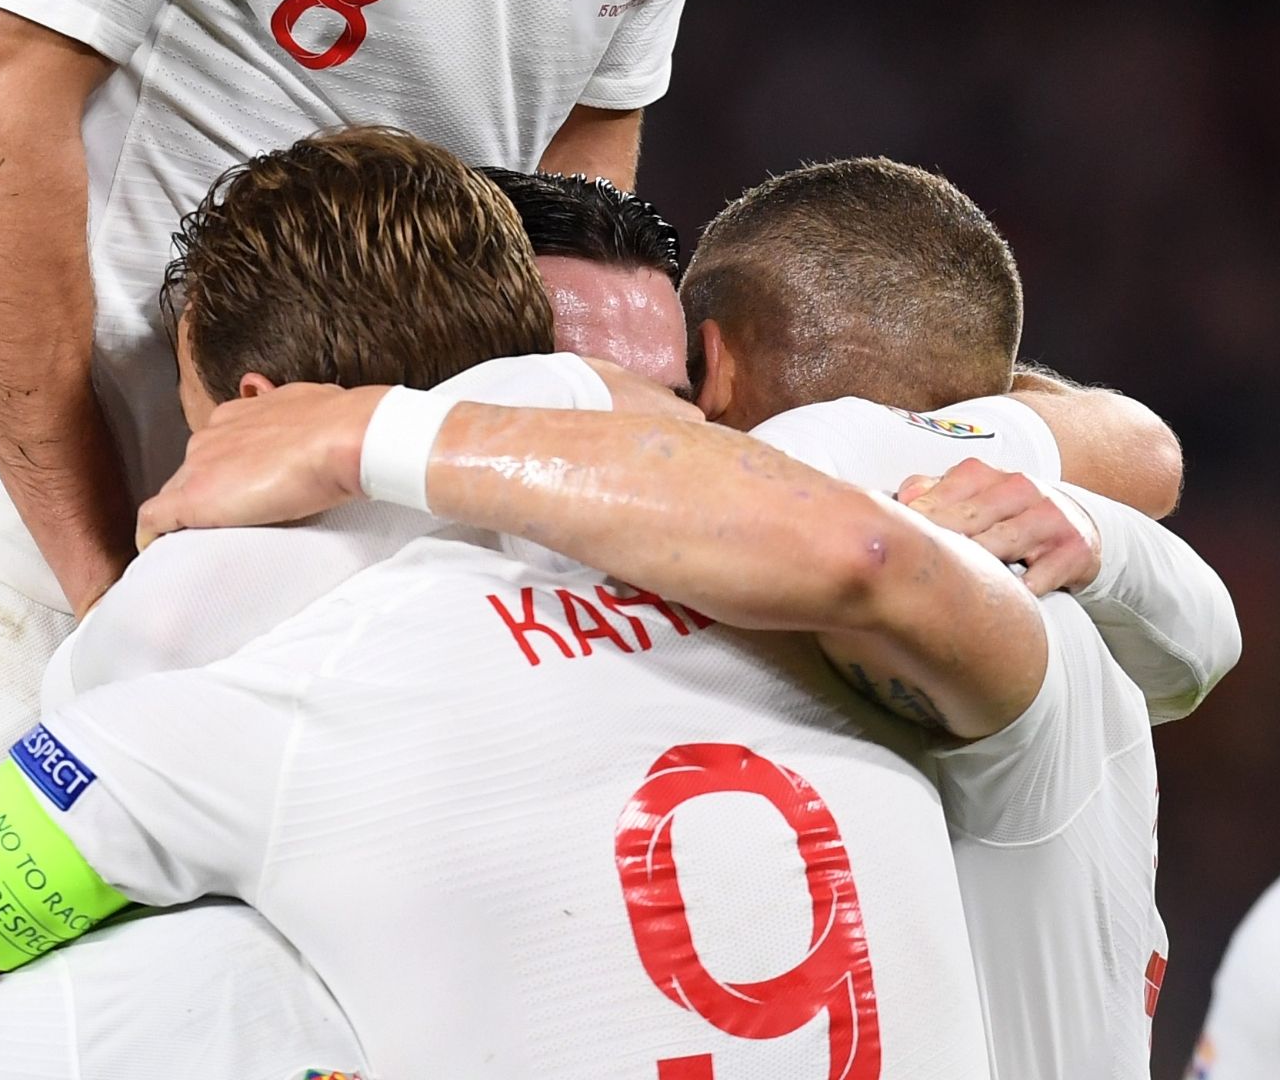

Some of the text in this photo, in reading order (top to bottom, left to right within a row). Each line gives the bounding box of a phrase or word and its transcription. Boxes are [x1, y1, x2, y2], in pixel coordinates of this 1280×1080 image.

[486, 580, 718, 667] KAN
[16, 853, 47, 890] TO
[42, 891, 94, 933] RAC
[614, 742, 882, 1080] 9
